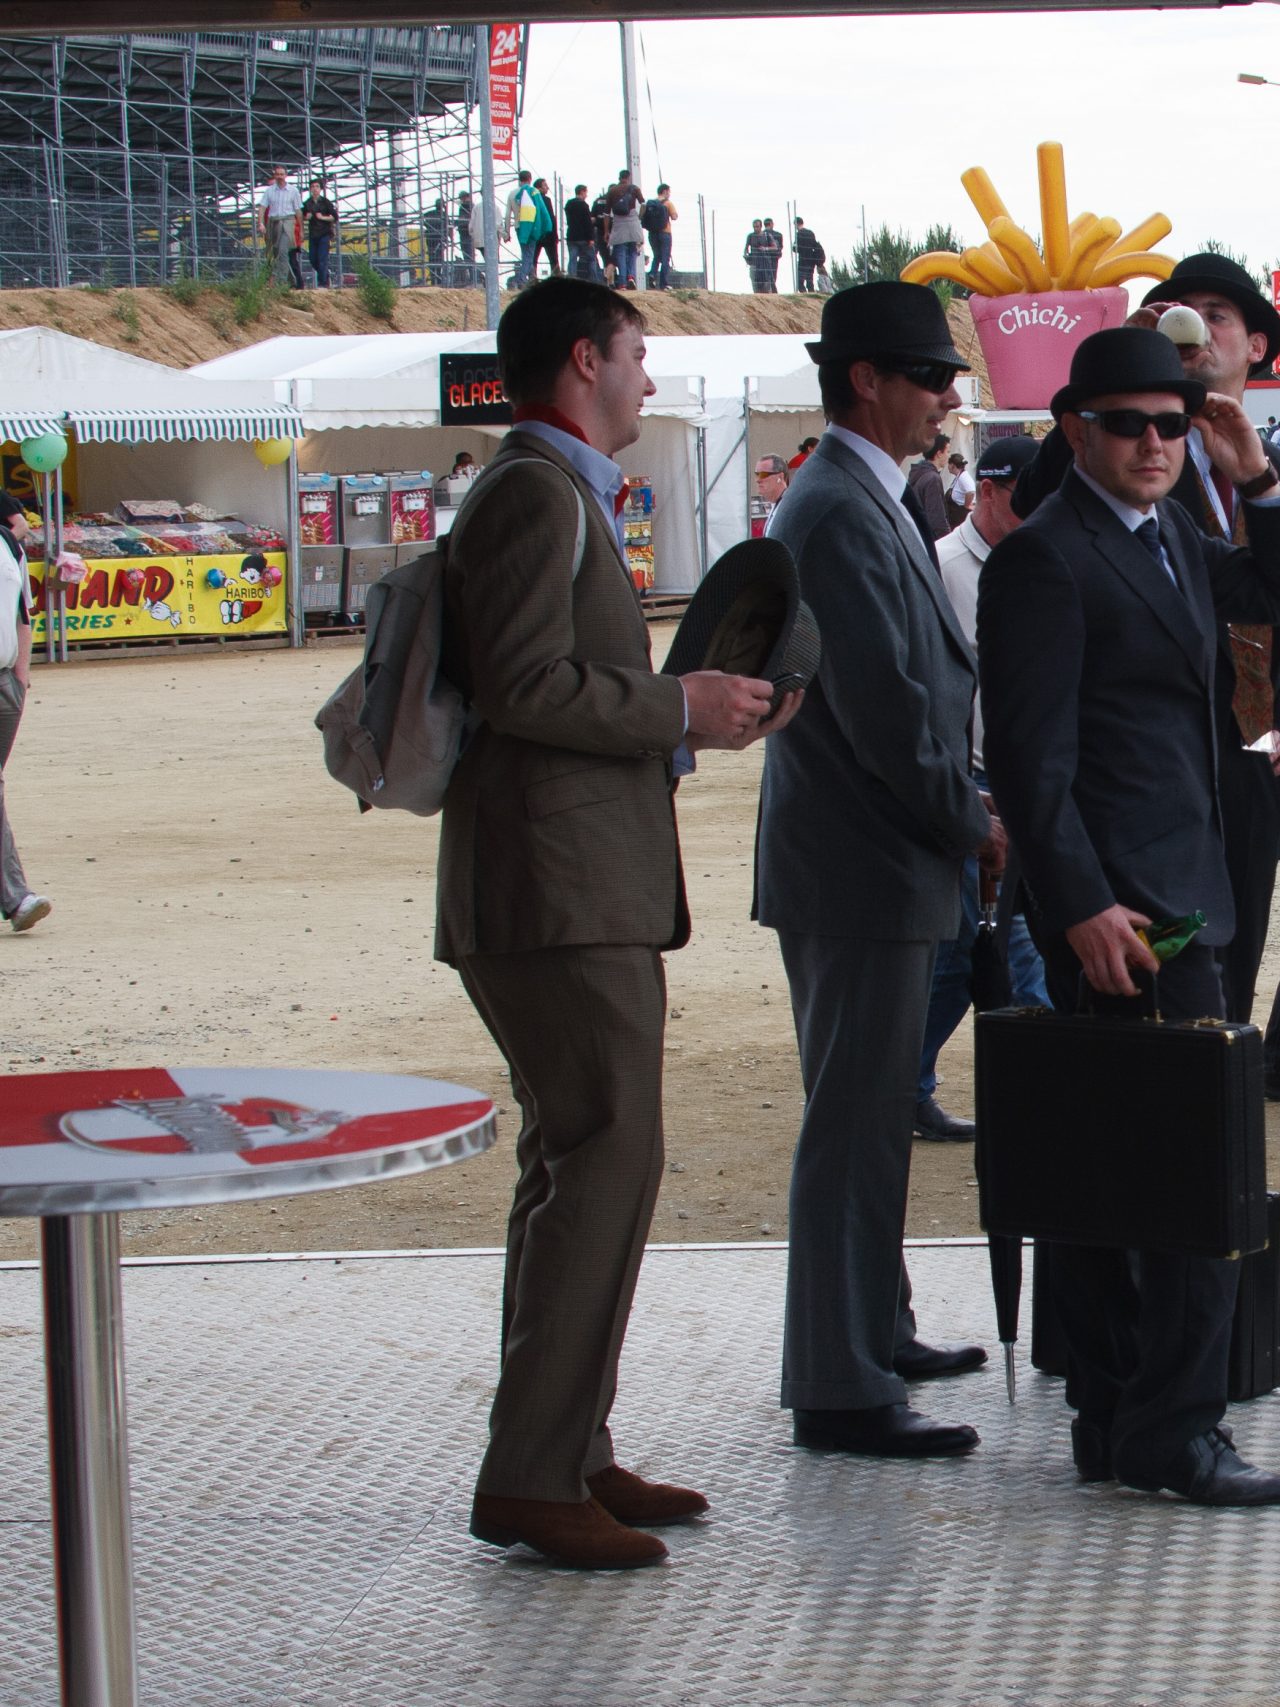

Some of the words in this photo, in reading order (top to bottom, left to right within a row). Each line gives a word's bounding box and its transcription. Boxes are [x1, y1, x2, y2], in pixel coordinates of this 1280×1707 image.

[493, 28, 517, 56] 24
[998, 302, 1081, 335] Chichi
[226, 587, 265, 599] HARIBO
